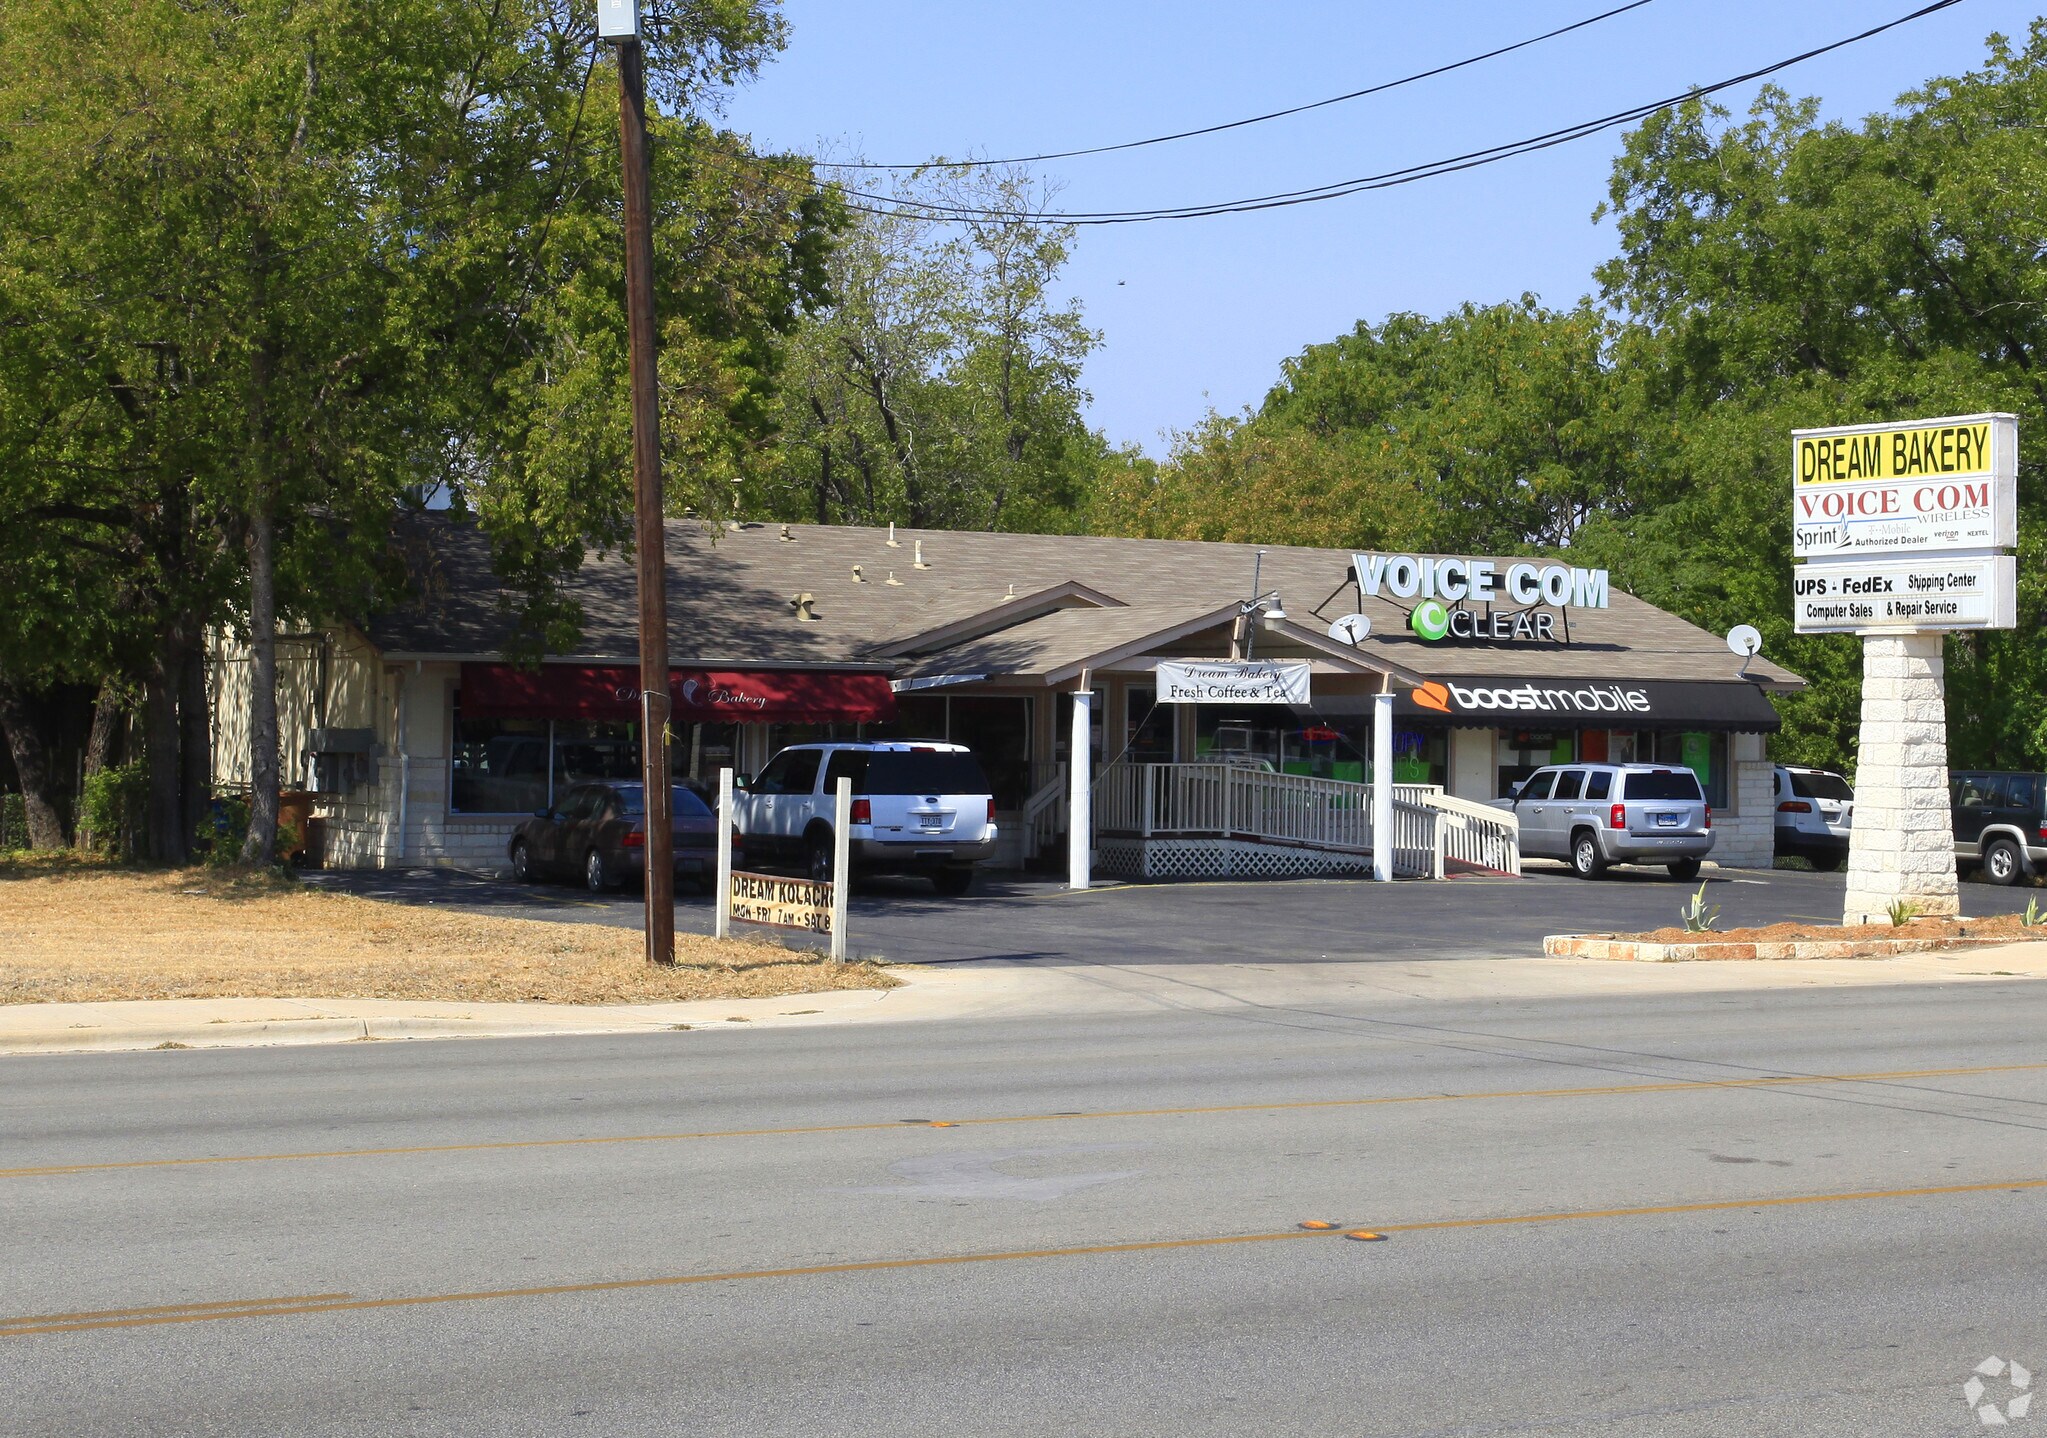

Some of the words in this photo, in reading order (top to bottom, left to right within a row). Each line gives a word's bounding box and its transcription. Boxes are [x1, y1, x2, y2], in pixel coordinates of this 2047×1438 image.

[1802, 435, 1881, 483] DREAM
[1892, 426, 1988, 476] BAKERY
[1799, 489, 1900, 519] VOICE
[1913, 483, 1989, 513] COM
[1916, 508, 1990, 524] WIRELESS
[1796, 526, 1838, 551] Sprint
[1855, 537, 1899, 547] Authorized
[1901, 535, 1928, 545] Dealer
[1351, 553, 1495, 602] VOICE
[1505, 562, 1609, 609] COM
[1795, 579, 1827, 596] UPS
[1842, 576, 1893, 595] FedEx
[1908, 574, 1945, 592] Shipping
[1946, 572, 1976, 588] Center
[1806, 603, 1847, 620] Computer
[1849, 603, 1873, 618] Sales
[1886, 601, 1893, 616] &
[1895, 600, 1922, 618] Repair
[1924, 599, 1958, 615] Service
[1450, 609, 1555, 640] CLEAR
[1184, 665, 1228, 679] Dream
[1234, 666, 1282, 684] Bakery
[708, 689, 767, 709] Bakery
[1170, 685, 1203, 698] Fresh
[1208, 685, 1247, 698] Coffee
[1249, 688, 1260, 698] &
[1264, 686, 1286, 698] Tea
[1392, 731, 1425, 753] OPY
[733, 876, 774, 902] DREAM
[804, 912, 822, 929] SAT
